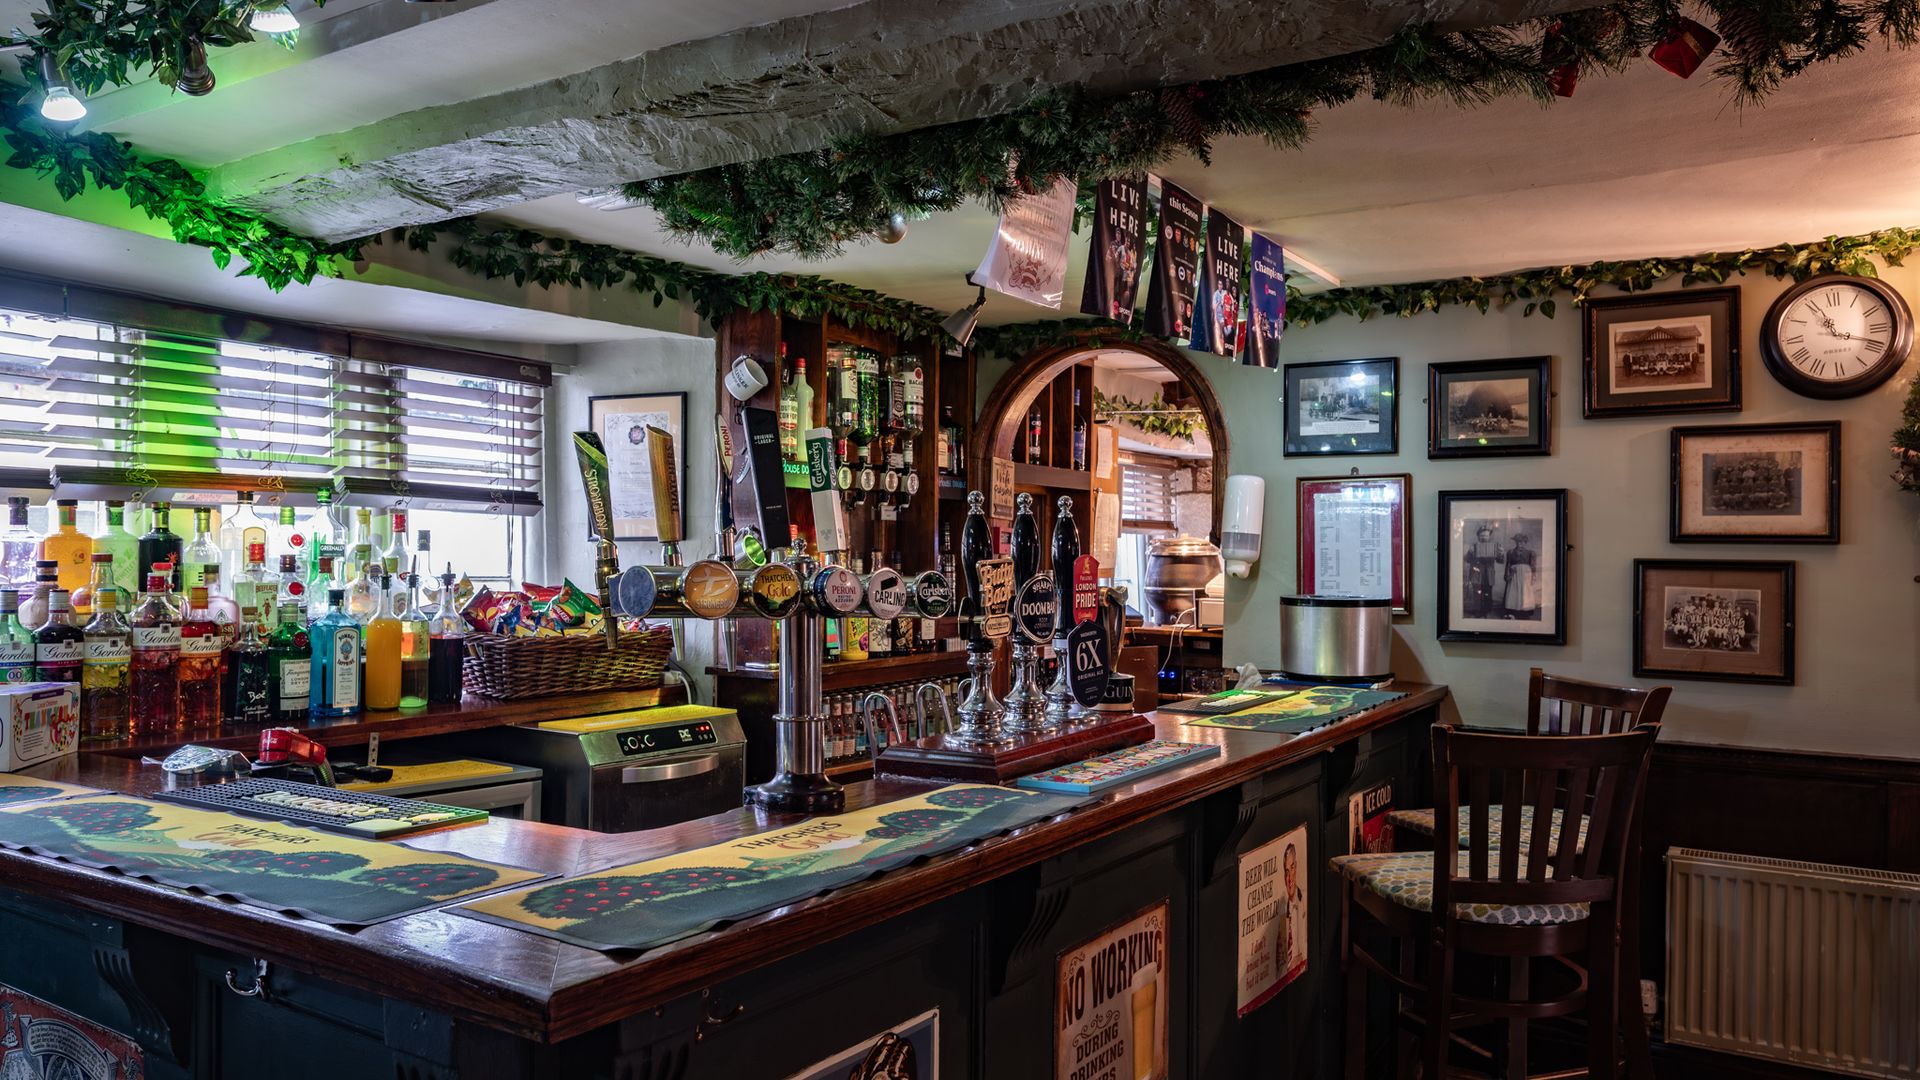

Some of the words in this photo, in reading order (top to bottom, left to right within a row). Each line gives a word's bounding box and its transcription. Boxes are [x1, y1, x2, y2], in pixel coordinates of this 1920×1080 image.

[1112, 180, 1140, 210] LIVE
[1169, 198, 1181, 212] this
[1182, 203, 1199, 222] Season
[1110, 208, 1139, 237] HERE
[1218, 236, 1238, 260] LIVE
[1216, 260, 1238, 282] HERE
[1254, 260, 1284, 282] Champions
[720, 425, 732, 457] PERONI
[811, 442, 825, 488] Carlsberg
[667, 445, 680, 513] THATCHERS
[585, 469, 608, 530] STRONGBOW
[760, 573, 795, 584] THATCHERS
[832, 585, 856, 595] PERONI
[767, 582, 791, 600] Gold
[875, 590, 905, 607] CARLING
[1076, 593, 1096, 608] PRIDE
[695, 598, 733, 610] STRONGBOW
[1076, 639, 1103, 672] 6X
[1078, 673, 1096, 681] ORIGINAL
[1366, 791, 1376, 814] ICE
[1376, 784, 1392, 809] COLD
[217, 824, 319, 845] THATCHERS
[731, 821, 842, 849] THATCHERS
[777, 831, 856, 851] Gold
[1245, 864, 1262, 890] BEER
[1263, 856, 1278, 877] WILL
[1247, 880, 1273, 910] CHANGE
[1242, 915, 1256, 937] THE
[1061, 965, 1084, 1032] NO
[1091, 930, 1162, 1008] WORKING
[1076, 1021, 1119, 1064] DURING
